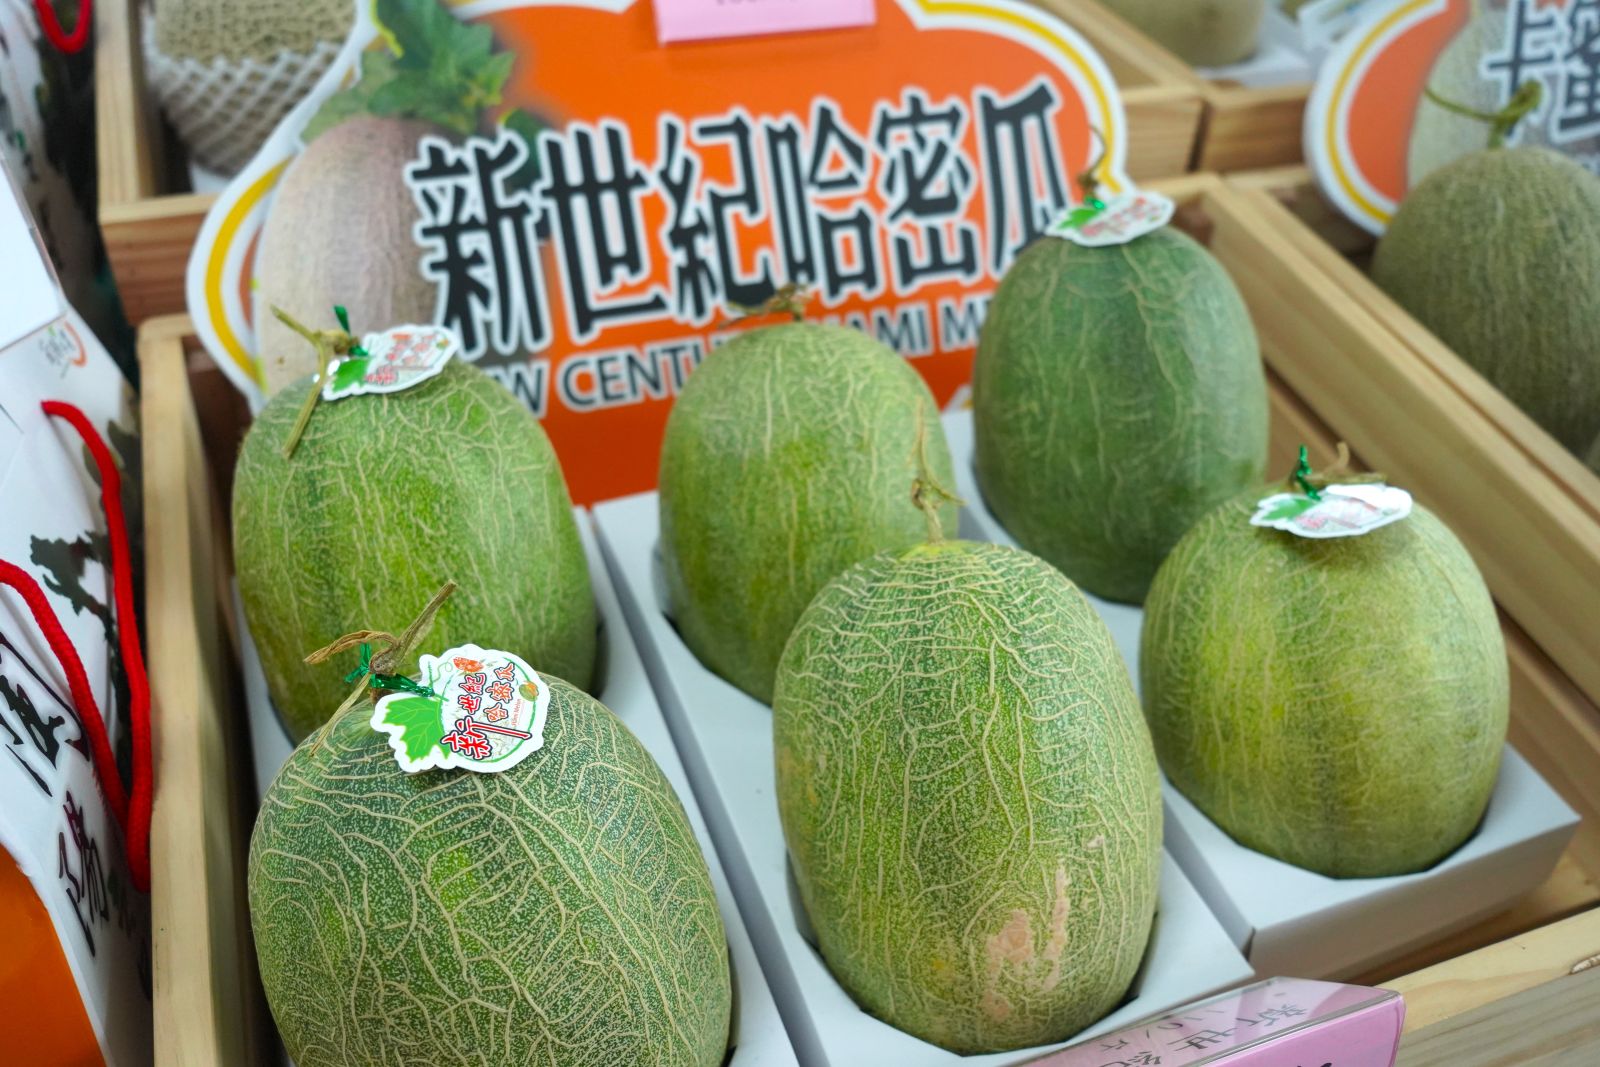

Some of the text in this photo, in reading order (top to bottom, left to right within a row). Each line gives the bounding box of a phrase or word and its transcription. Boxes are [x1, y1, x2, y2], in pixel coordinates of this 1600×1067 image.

[410, 80, 1066, 353] 新世紀哈密瓜
[561, 340, 720, 406] CENT
[440, 672, 533, 761] 新世紀
[483, 661, 516, 723] 哈密瓜
